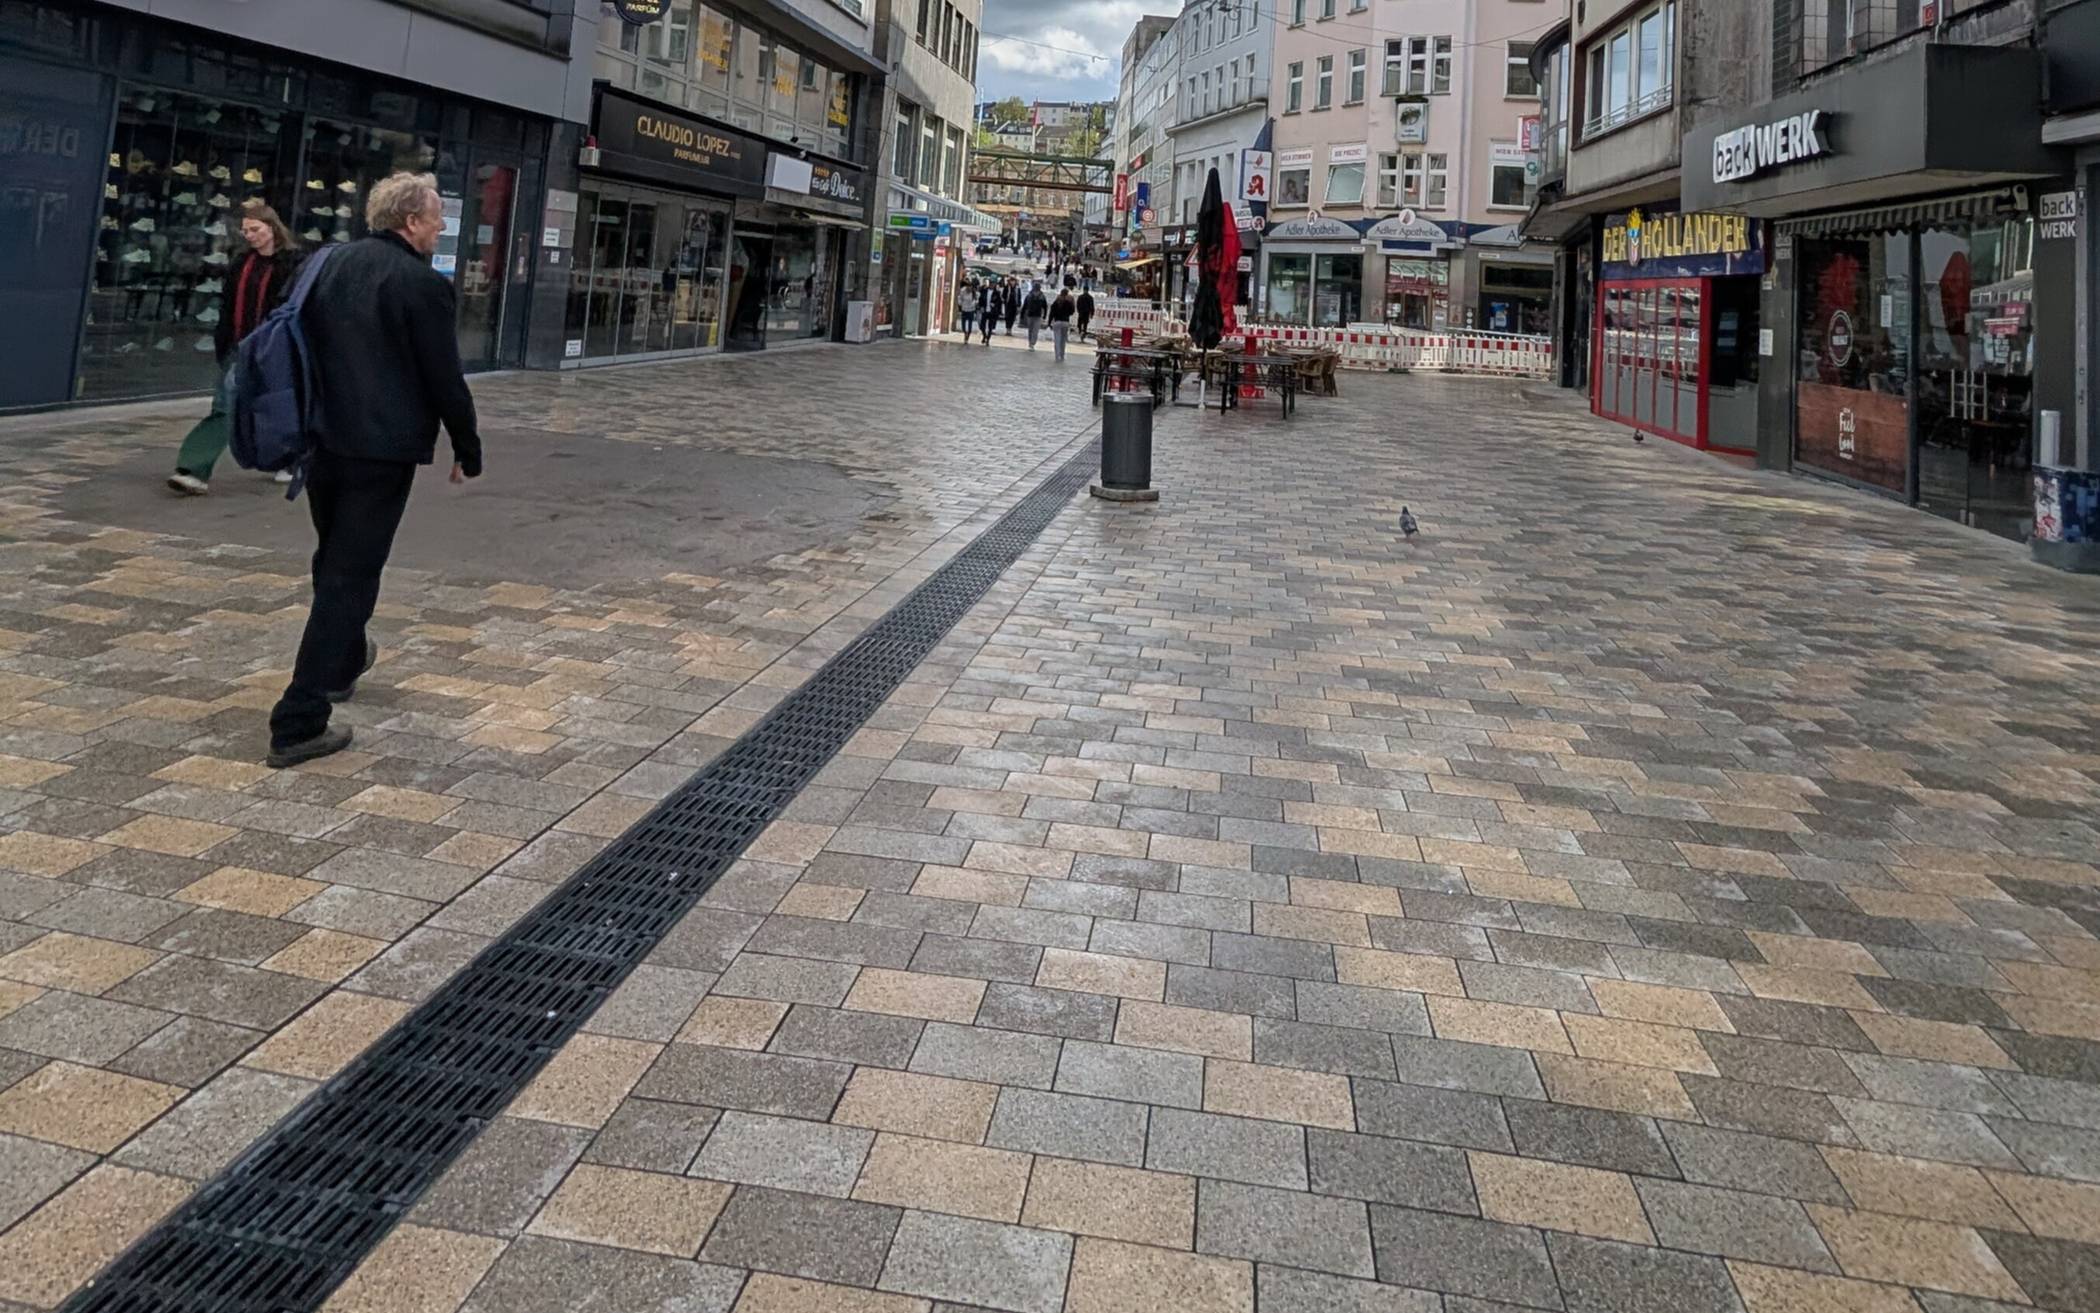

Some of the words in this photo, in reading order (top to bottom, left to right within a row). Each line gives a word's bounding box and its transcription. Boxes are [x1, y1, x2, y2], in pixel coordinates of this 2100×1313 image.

[637, 116, 693, 147] CLAUDIO
[697, 132, 730, 157] LOPEZ
[2042, 195, 2075, 218] back
[1285, 225, 1304, 235] Adler
[1306, 224, 1340, 237] Apotheke
[1376, 226, 1397, 235] Adler
[1400, 226, 1440, 238] Apotheke
[2041, 221, 2076, 239] WERK
[1602, 226, 1627, 262] DER
